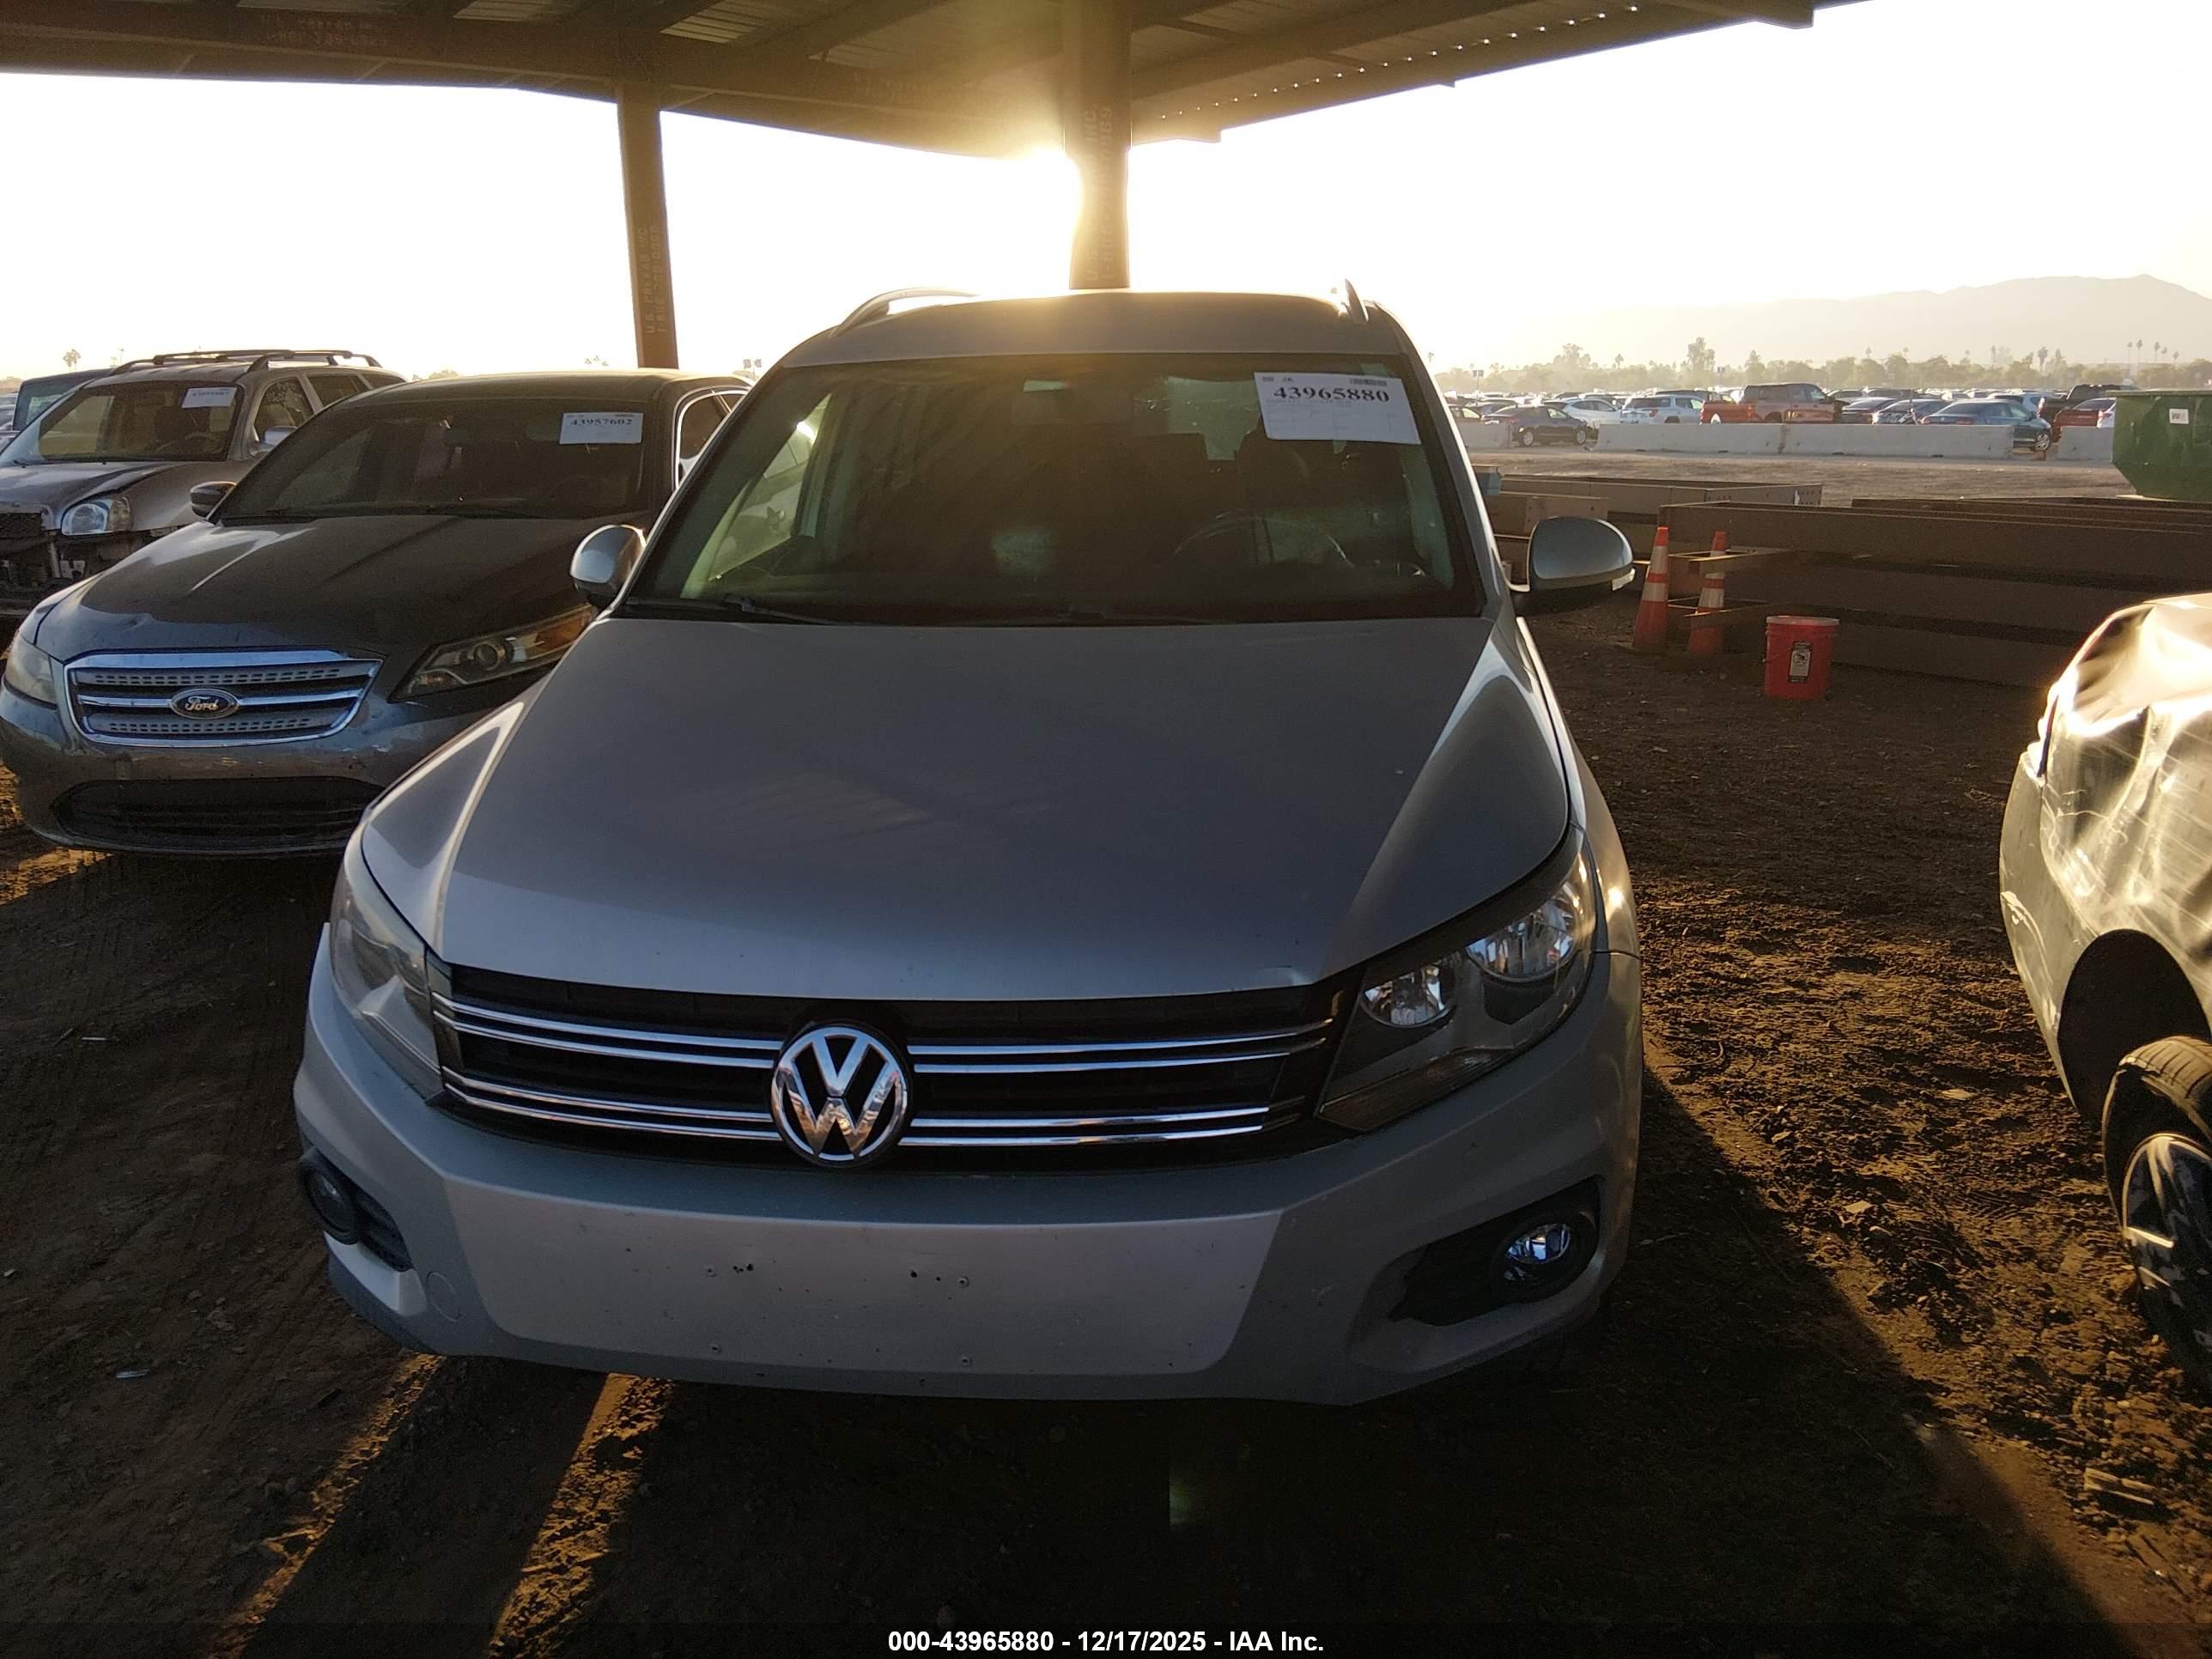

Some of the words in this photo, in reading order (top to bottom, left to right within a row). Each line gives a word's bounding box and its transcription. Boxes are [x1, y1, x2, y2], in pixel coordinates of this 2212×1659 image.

[1273, 386, 1389, 403] 43965880
[185, 696, 220, 712] Ford
[771, 1026, 908, 1162] VW
